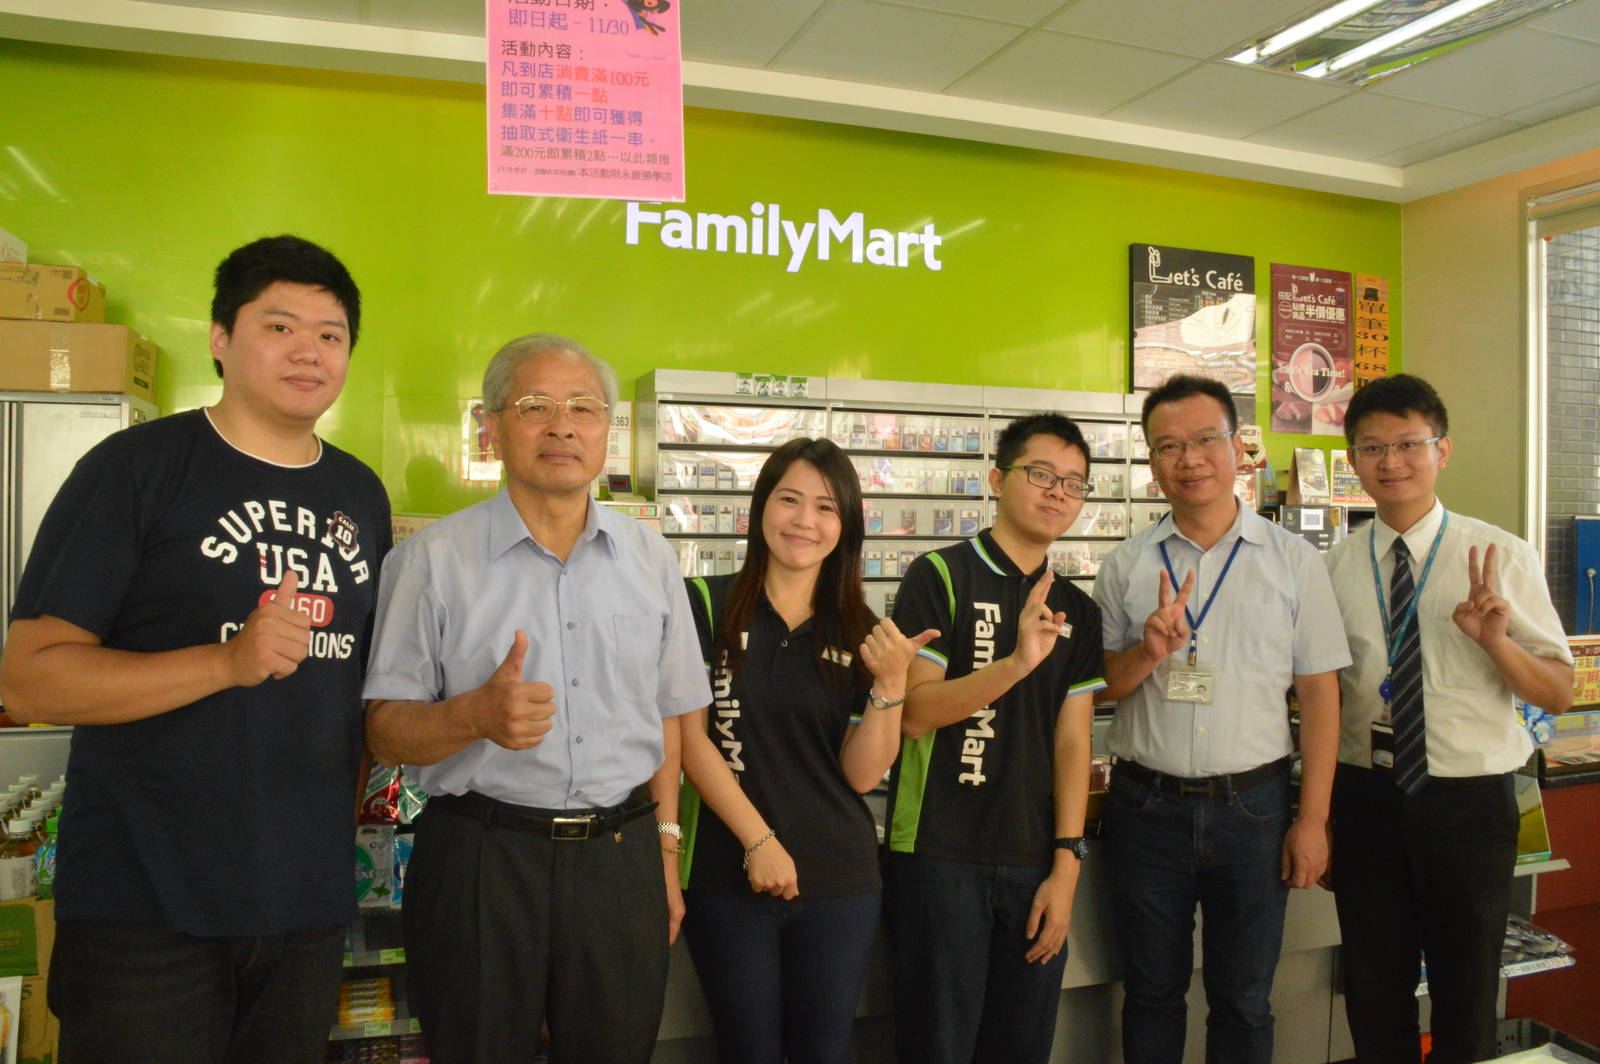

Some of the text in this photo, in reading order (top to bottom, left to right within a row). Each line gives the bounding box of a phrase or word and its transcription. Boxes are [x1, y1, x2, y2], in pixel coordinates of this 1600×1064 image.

[501, 82, 609, 104] 即可累積一點
[501, 103, 643, 126] 集滿十點即可獲得
[626, 201, 942, 272] FamilyMart
[1148, 246, 1243, 291] Let's Café
[335, 525, 353, 546] 10
[256, 542, 338, 593] USA
